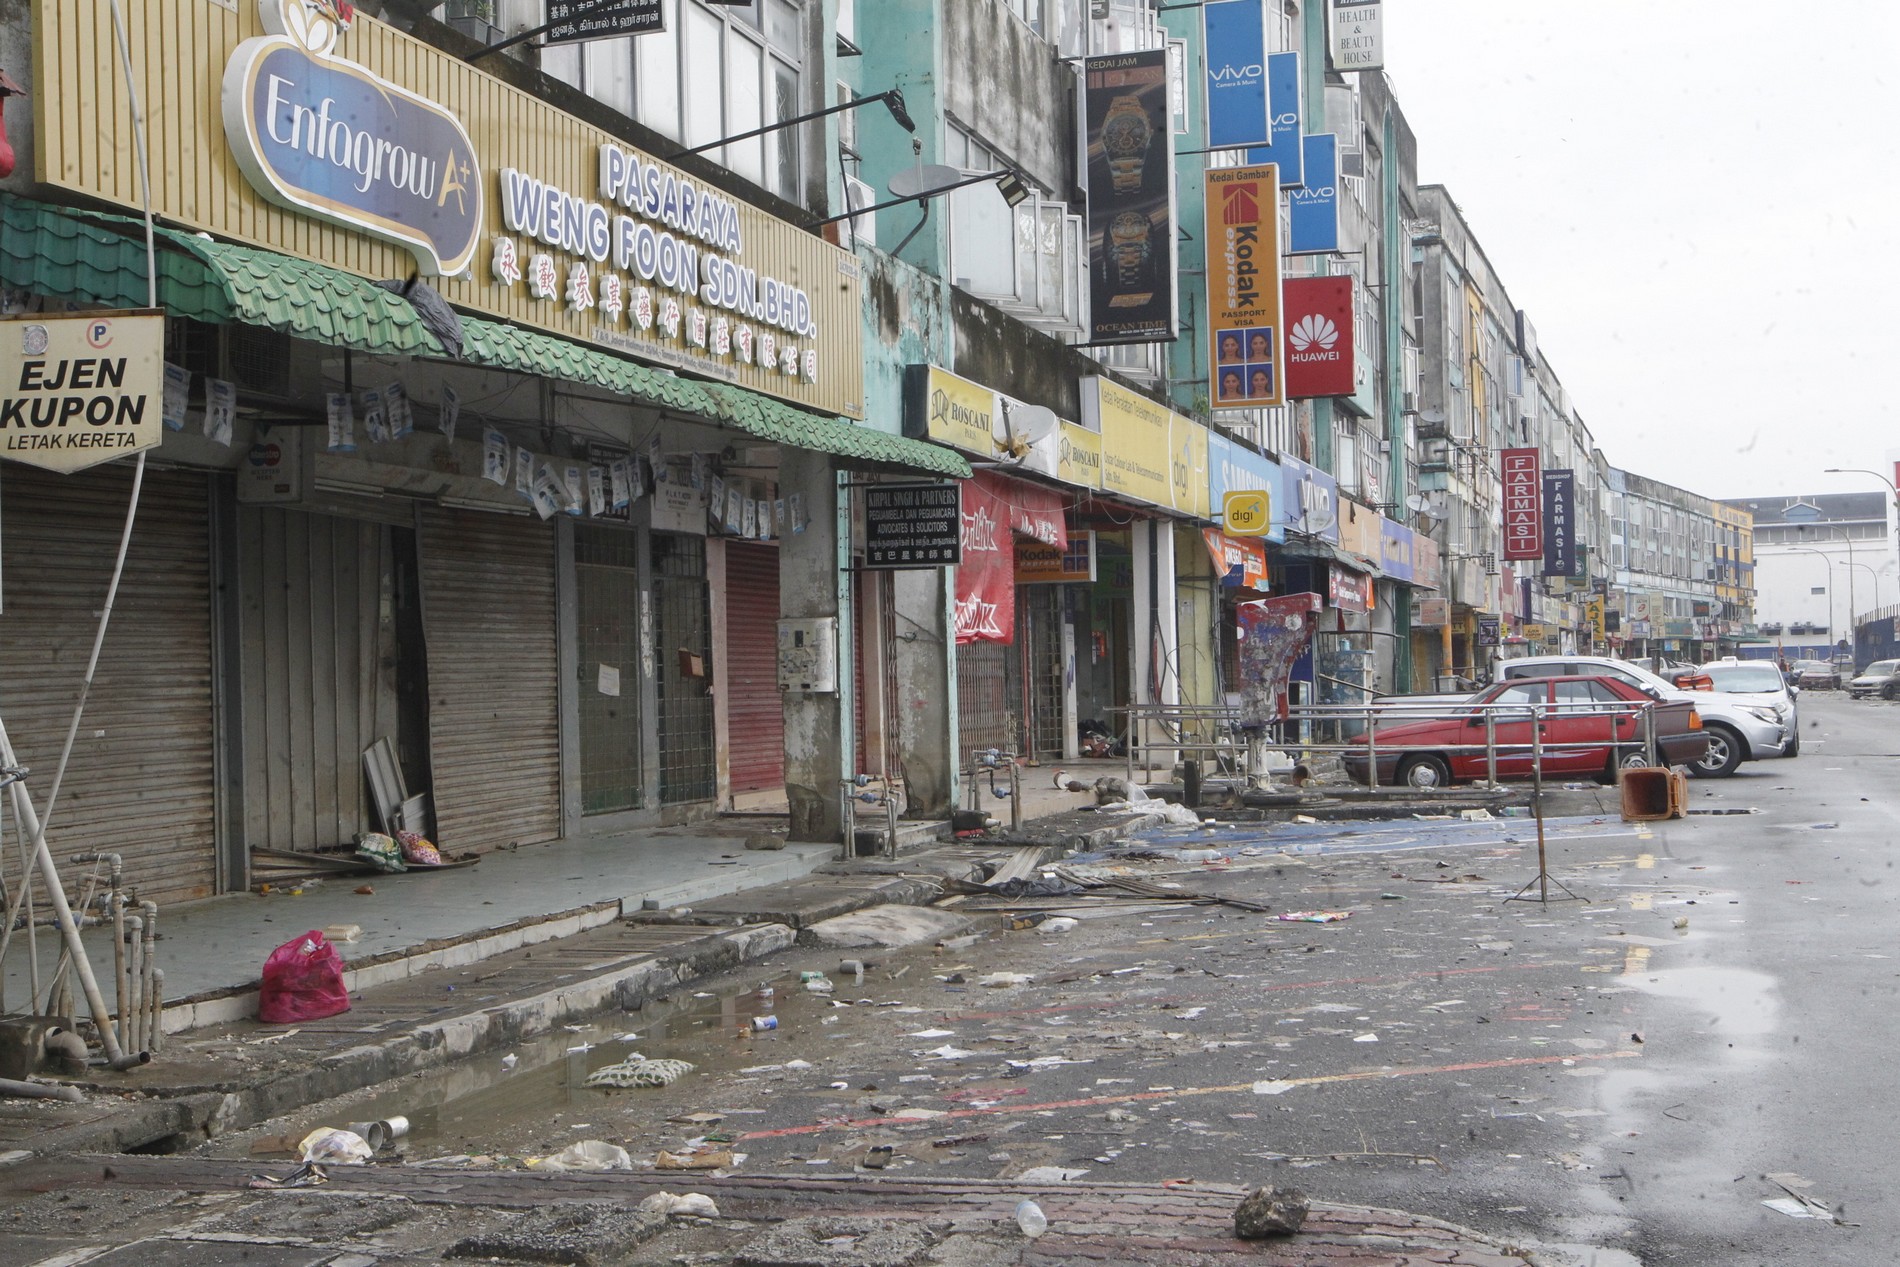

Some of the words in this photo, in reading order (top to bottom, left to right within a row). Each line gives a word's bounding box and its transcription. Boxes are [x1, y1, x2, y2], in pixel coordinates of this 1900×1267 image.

[612, 16, 618, 26] &
[1339, 9, 1375, 23] HEALTH
[1353, 25, 1361, 34] &
[1341, 36, 1375, 49] BEAUTY
[1087, 60, 1115, 69] KEDAI
[1117, 57, 1137, 67] JAM
[1343, 51, 1372, 64] HOUSE
[1209, 64, 1262, 81] vivo
[1271, 113, 1297, 126] vo
[266, 74, 436, 200] Enfagrow
[1209, 172, 1234, 183] Kedai
[1236, 170, 1270, 181] Gambar
[604, 144, 742, 255] PASARAYA
[1291, 186, 1335, 199] vivo
[502, 167, 610, 262] WENG
[614, 215, 699, 296] FOON
[1226, 228, 1237, 309] express
[1236, 225, 1260, 308] Kodak
[1221, 309, 1266, 318] PASSPORT
[1096, 322, 1134, 332] OCEAN
[1137, 320, 1166, 329] TIME
[1291, 351, 1339, 362] HUAWEI
[19, 358, 127, 391] EJEN
[0, 395, 147, 428] KUPON
[951, 401, 990, 432] ROSCANI
[7, 434, 62, 450] LETAK
[66, 432, 136, 449] KERETA
[1072, 446, 1099, 468] ROSCANI
[1173, 453, 1188, 498] digi
[868, 492, 892, 507] KIRPAL
[894, 490, 913, 506] SINGH
[921, 489, 956, 505] PARTNERS
[1514, 459, 1529, 549] FARMASI
[868, 509, 904, 520] PEGUAMBELA
[906, 508, 917, 519] DAN
[918, 507, 956, 518] PEGUAMCARA
[1232, 509, 1253, 523] digi
[1553, 481, 1565, 559] FARMASI
[877, 522, 908, 534] ADVOCATES
[910, 523, 914, 533] &
[916, 521, 948, 532] SOLICITORS
[1020, 549, 1061, 560] Kodak
